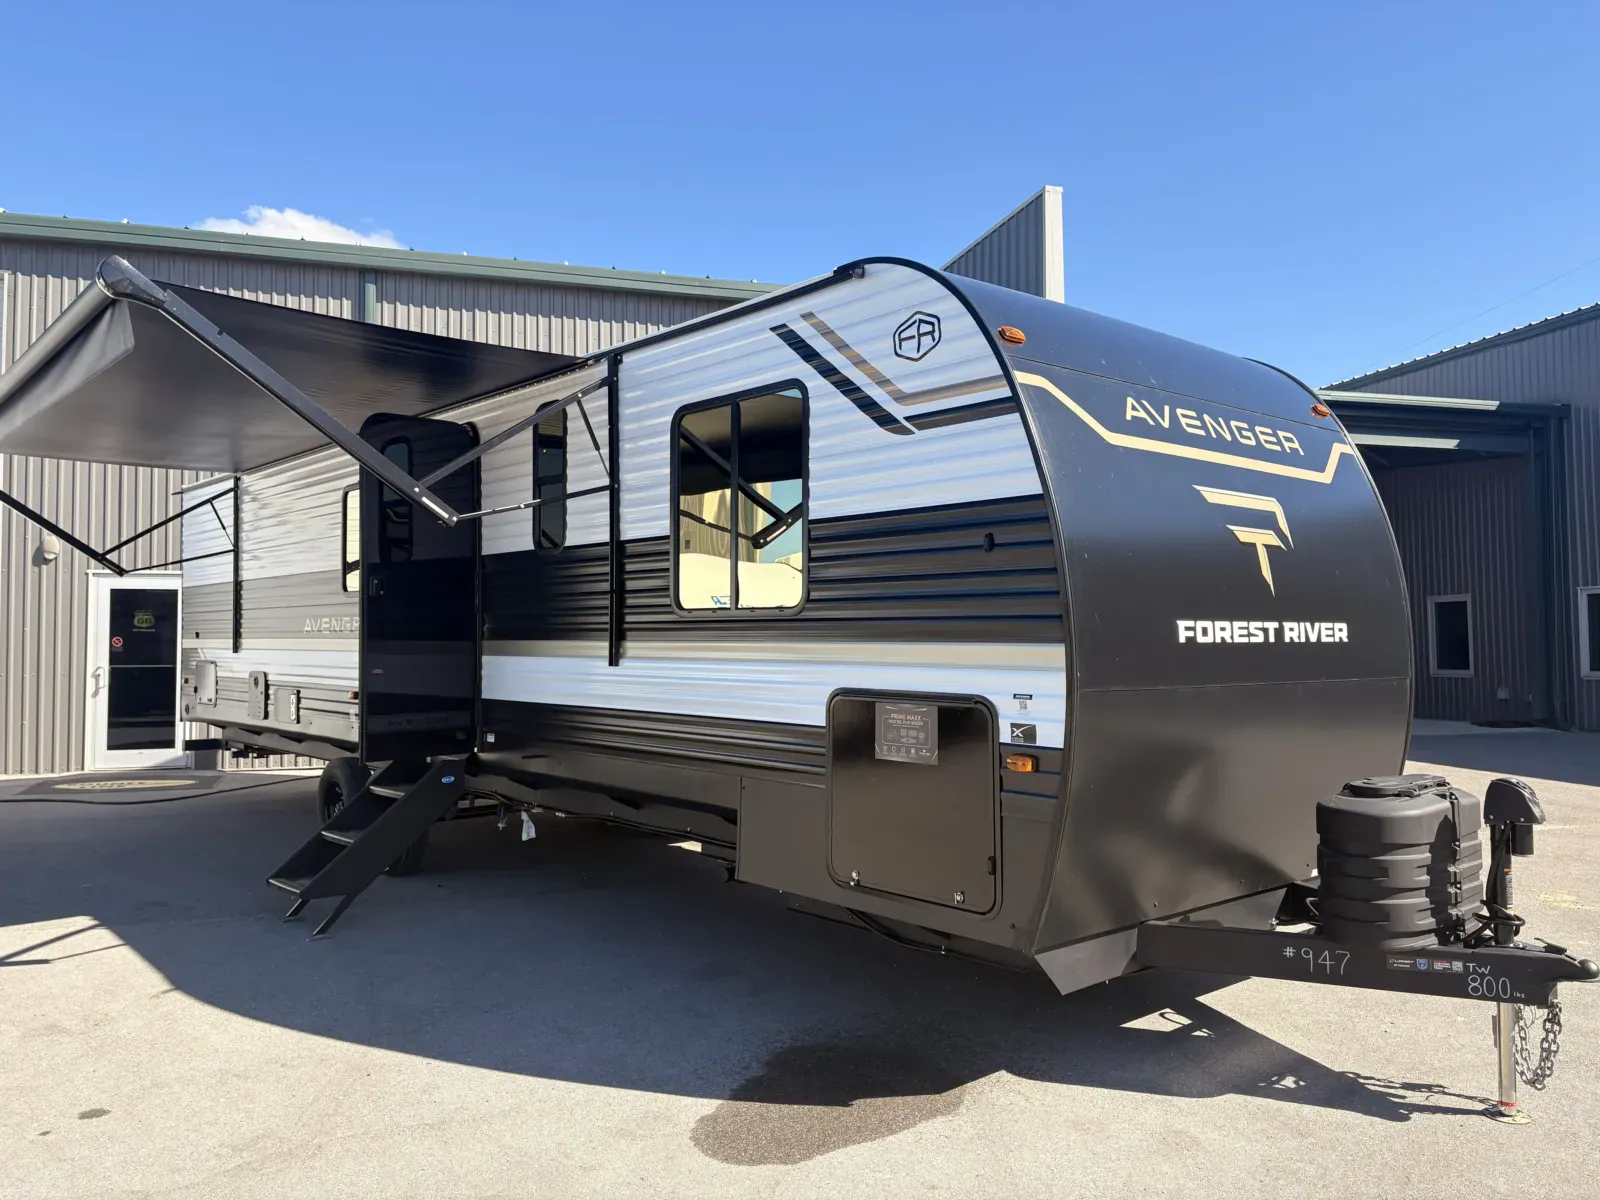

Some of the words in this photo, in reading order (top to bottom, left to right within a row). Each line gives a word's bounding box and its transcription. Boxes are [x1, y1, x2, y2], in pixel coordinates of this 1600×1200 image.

[1125, 396, 1305, 456] AVENGER
[303, 616, 360, 634] AVENGE
[1176, 619, 1279, 643] FOREST
[1282, 621, 1349, 643] RIVER
[1467, 975, 1511, 999] 800
